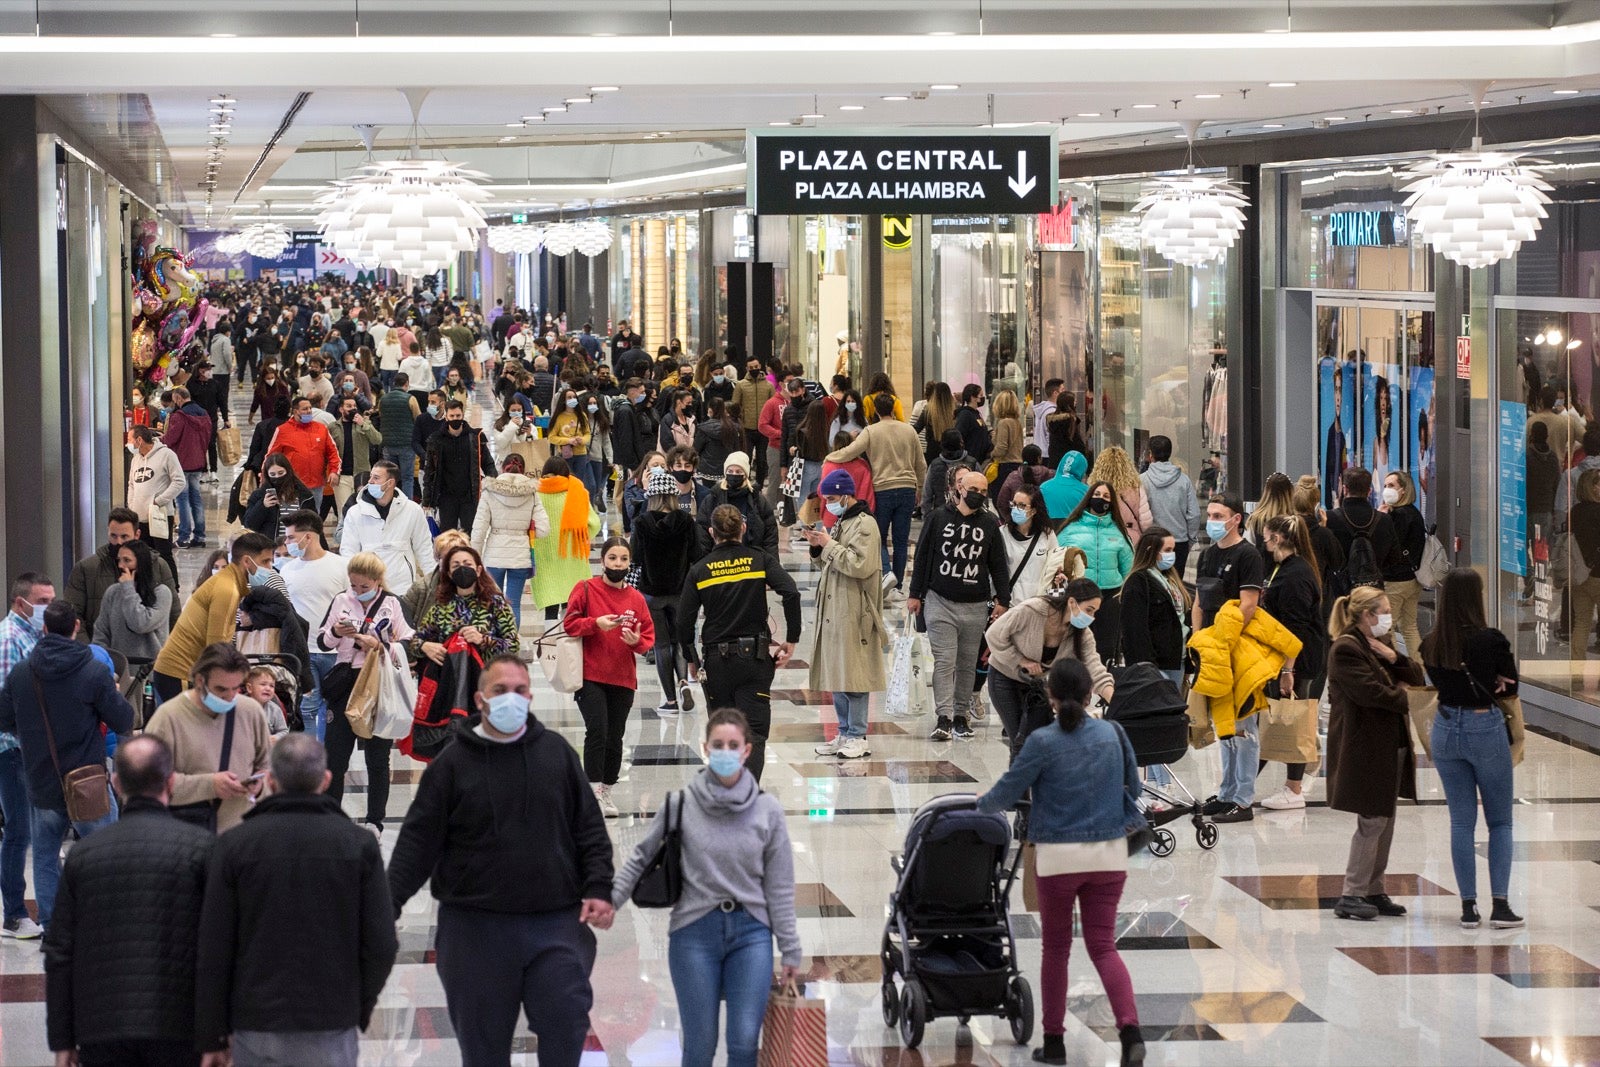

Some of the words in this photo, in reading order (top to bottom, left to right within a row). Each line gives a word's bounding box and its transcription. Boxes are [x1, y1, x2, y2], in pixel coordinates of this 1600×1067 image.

[779, 150, 868, 170] PLAZA
[876, 150, 1003, 170] CENTRAL
[795, 181, 864, 199] PLAZA
[866, 181, 986, 199] ALHAMBRA
[1329, 211, 1381, 246] PRIMARK
[706, 557, 753, 570] VIGILANT
[711, 566, 750, 577] SEGURIDAD
